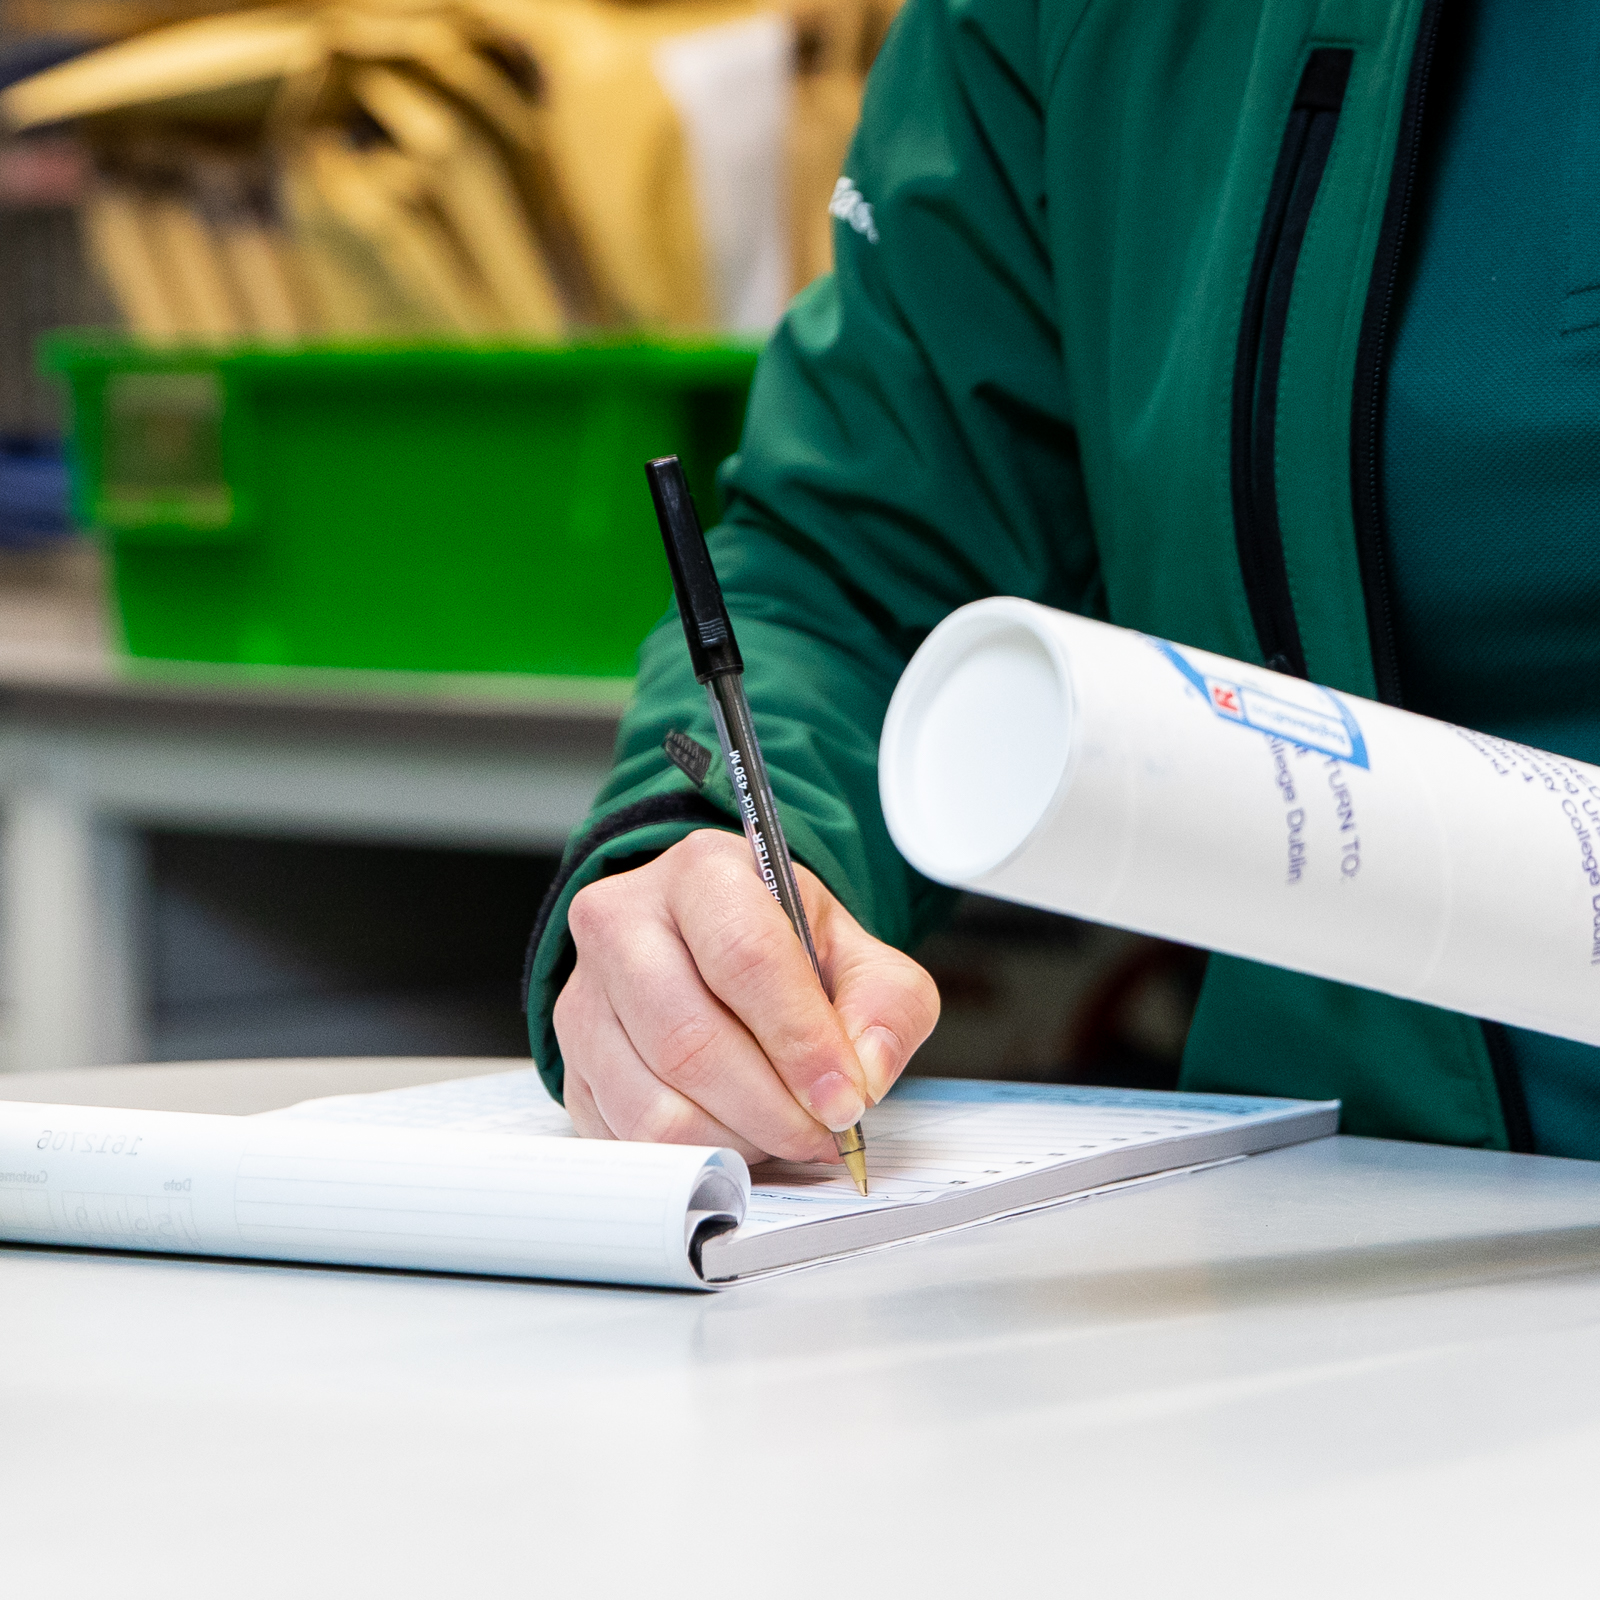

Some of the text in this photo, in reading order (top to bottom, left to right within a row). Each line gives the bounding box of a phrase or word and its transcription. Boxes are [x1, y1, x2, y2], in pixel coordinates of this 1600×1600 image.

[728, 749, 743, 764] M
[733, 765, 749, 791] 430
[1323, 756, 1356, 833] TURN
[741, 792, 759, 825] stick
[1286, 807, 1308, 886] Dublin
